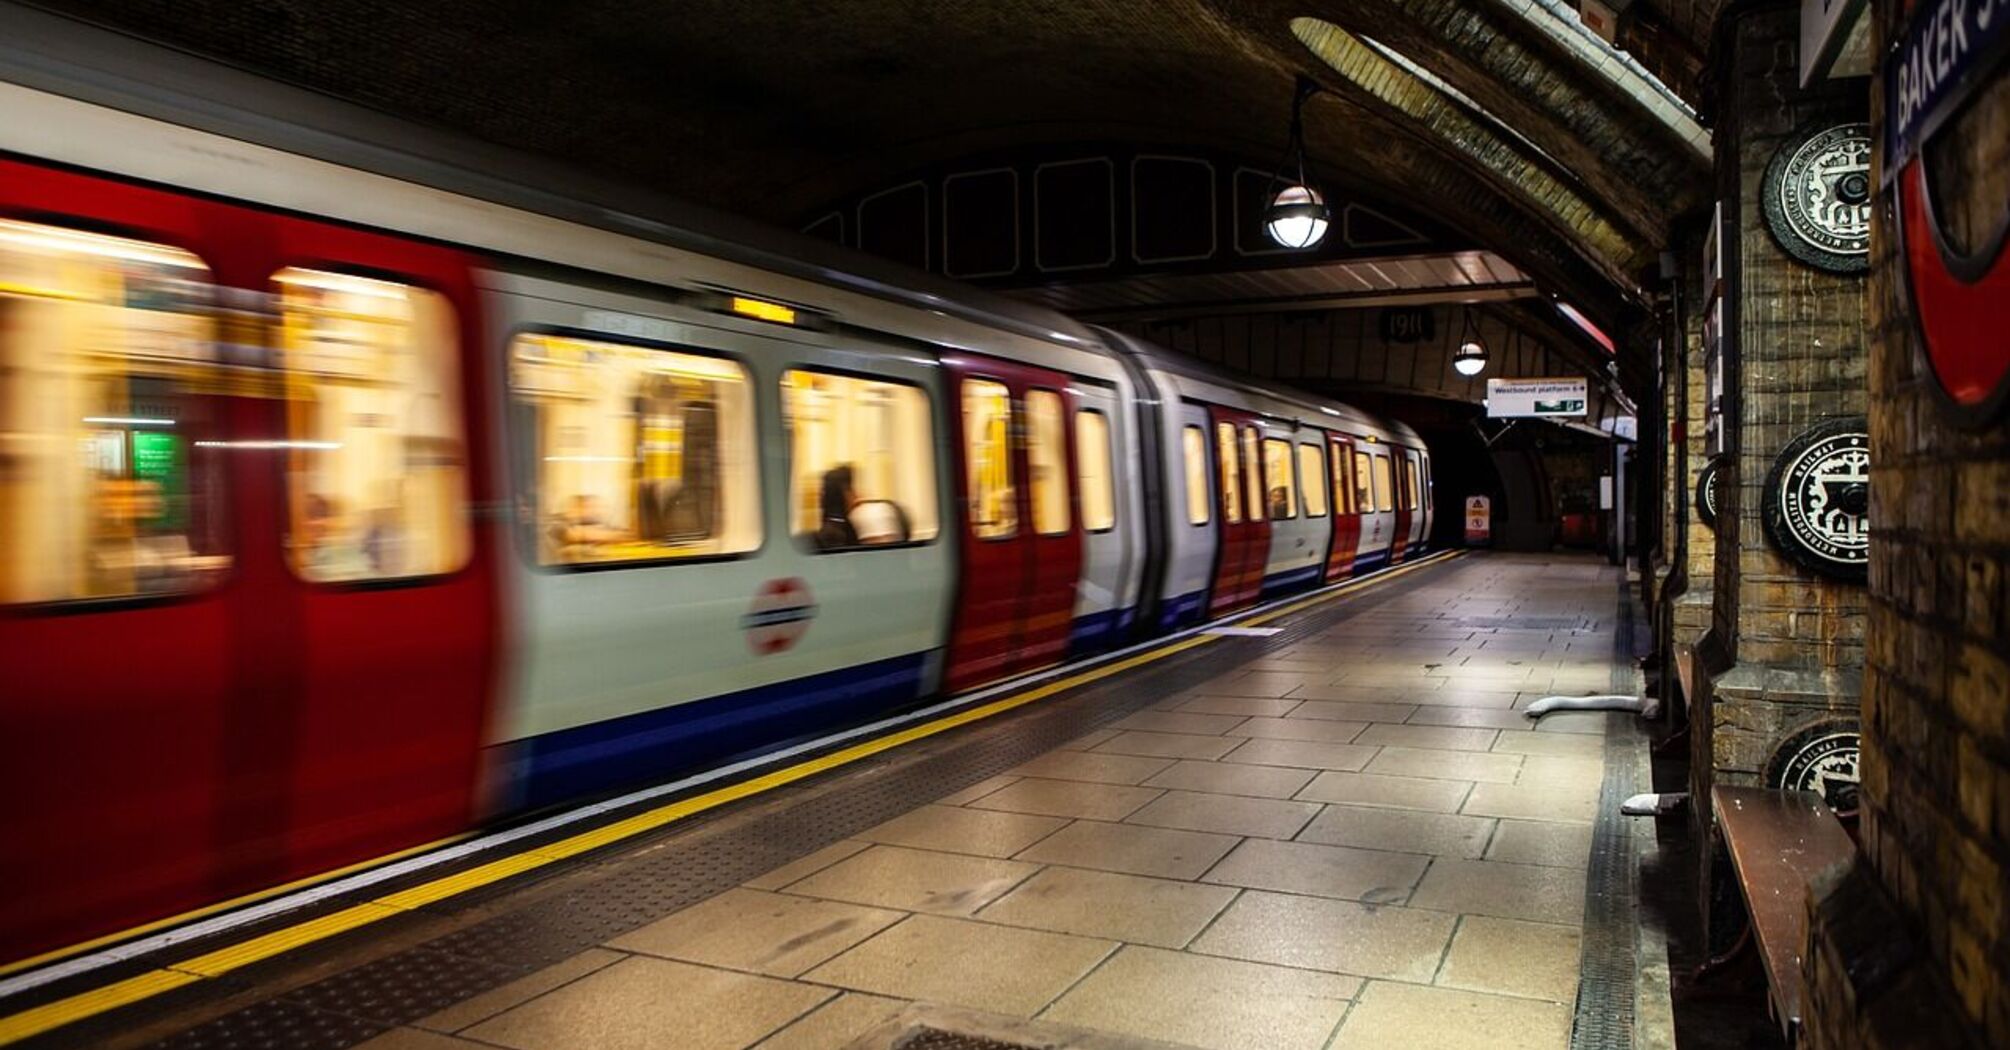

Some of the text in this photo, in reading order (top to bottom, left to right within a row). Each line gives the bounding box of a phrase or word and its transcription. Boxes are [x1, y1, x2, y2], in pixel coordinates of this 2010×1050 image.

[1898, 0, 1968, 134] BAKER
[1390, 312, 1422, 337] 1911
[1494, 386, 1536, 394] Westbound
[1538, 385, 1571, 394] platform
[1788, 443, 1838, 555] METROPOLITAN RAILWAY
[1795, 741, 1837, 770] RAILWAY
